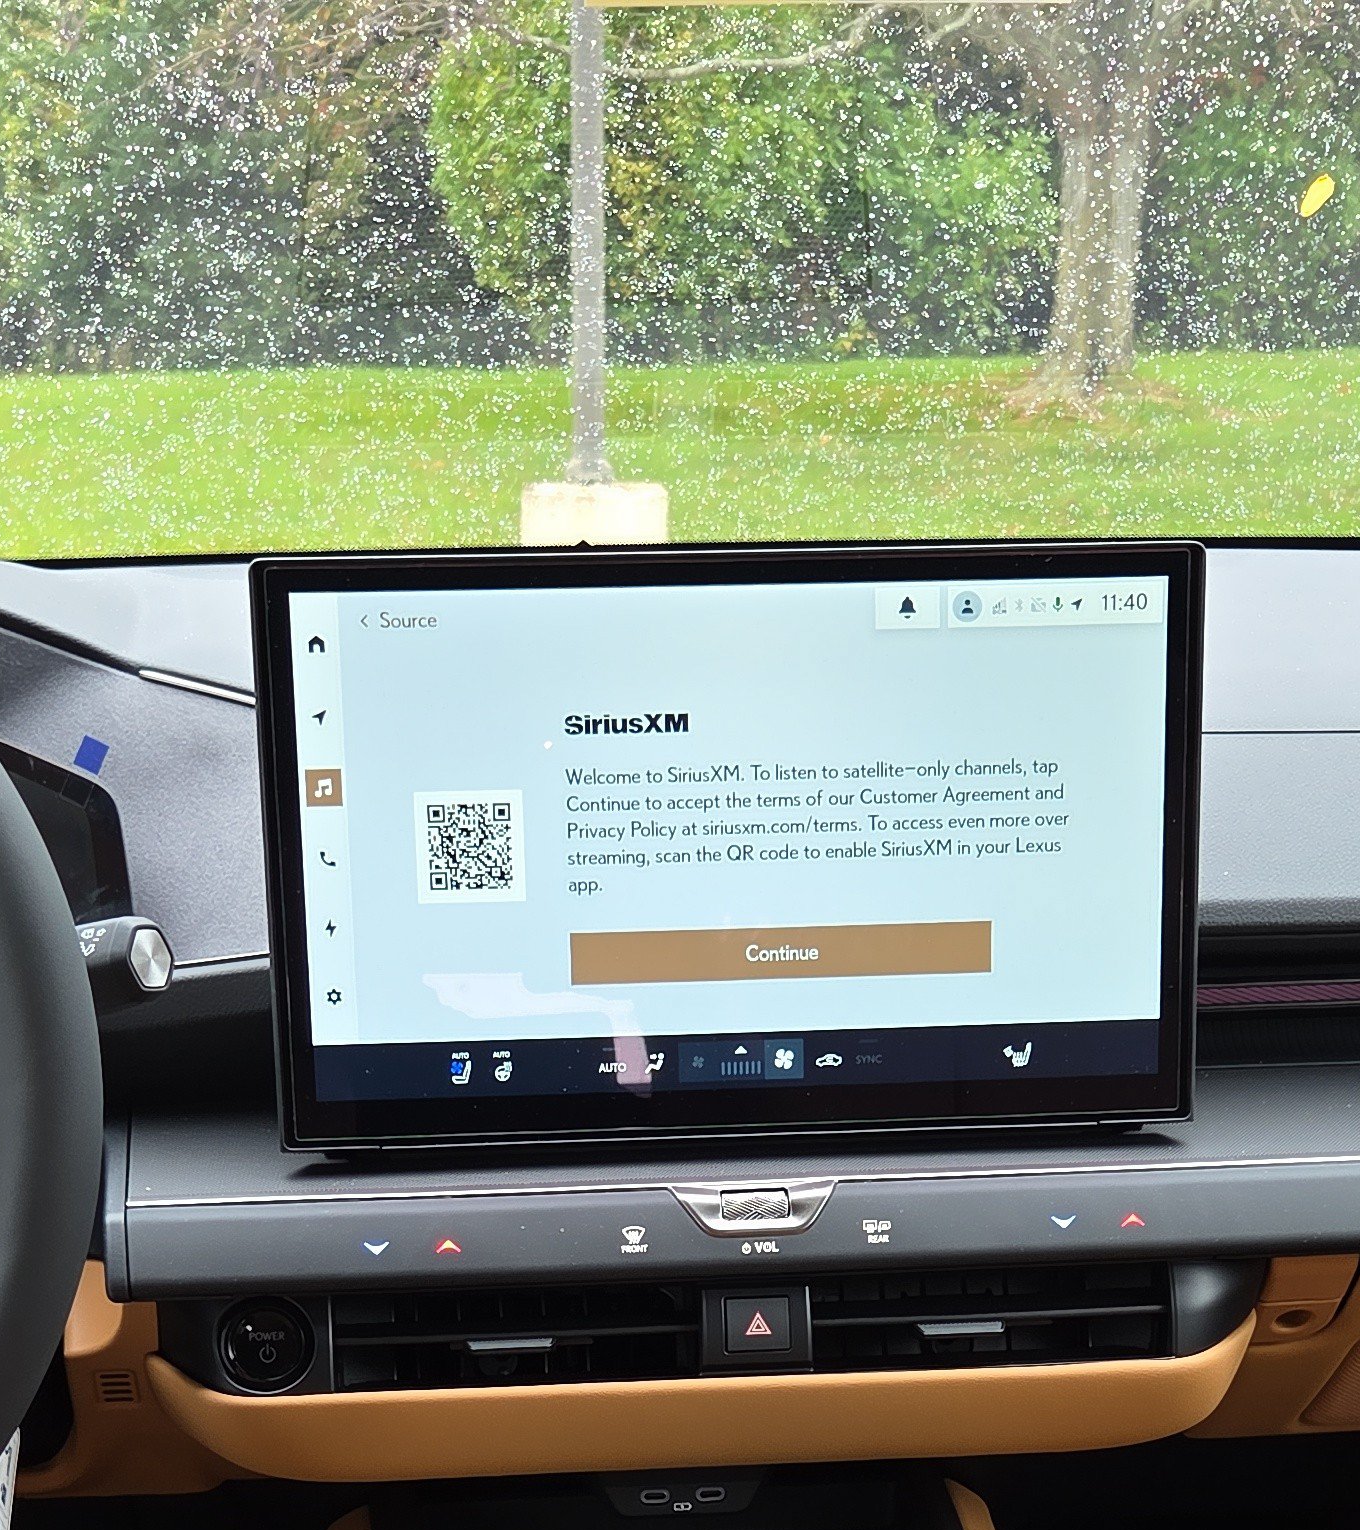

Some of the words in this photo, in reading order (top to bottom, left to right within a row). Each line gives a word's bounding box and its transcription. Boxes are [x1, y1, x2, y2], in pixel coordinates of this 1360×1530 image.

[1101, 593, 1148, 611] 11:40
[380, 612, 438, 629] Source
[565, 713, 689, 735] SiriusXM
[565, 768, 641, 785] Welcome
[646, 770, 662, 783] to
[668, 765, 745, 783] SiriusXM.
[750, 765, 771, 781] To
[775, 764, 816, 781] listen
[822, 765, 838, 780] to
[955, 758, 1027, 777] channels,
[1033, 760, 1058, 776] tap
[566, 795, 640, 812] Continue
[645, 796, 662, 810] to
[667, 795, 720, 813] accept
[726, 792, 752, 808] the
[757, 793, 801, 808] terms
[806, 790, 823, 806] of
[828, 792, 855, 806] our
[860, 788, 938, 805] Customer
[943, 786, 1030, 806] Agreement
[1035, 783, 1064, 800] and
[567, 822, 625, 841] Privacy
[631, 820, 677, 840] Policy
[682, 822, 697, 836] at
[702, 816, 862, 836] siriusxm.com/terms.
[868, 815, 888, 831] To
[892, 817, 943, 831] access
[948, 816, 985, 829] even
[989, 815, 1030, 828] more
[1035, 815, 1069, 827] over
[567, 849, 650, 867] streaming,
[655, 851, 691, 863] scan
[696, 846, 722, 862] the
[727, 844, 754, 861] QR
[759, 844, 799, 860] code
[804, 846, 821, 859] to
[825, 841, 877, 859] enable
[881, 839, 952, 857] SiriusXM
[957, 840, 971, 855] in
[976, 842, 1011, 858] your
[1016, 837, 1061, 853] Lexus
[568, 880, 603, 896] app.
[745, 944, 819, 962] Continue
[599, 1063, 627, 1073] AUTO
[754, 1241, 779, 1253] VOL
[867, 1233, 890, 1243] REAR
[248, 1331, 285, 1342] POWER
